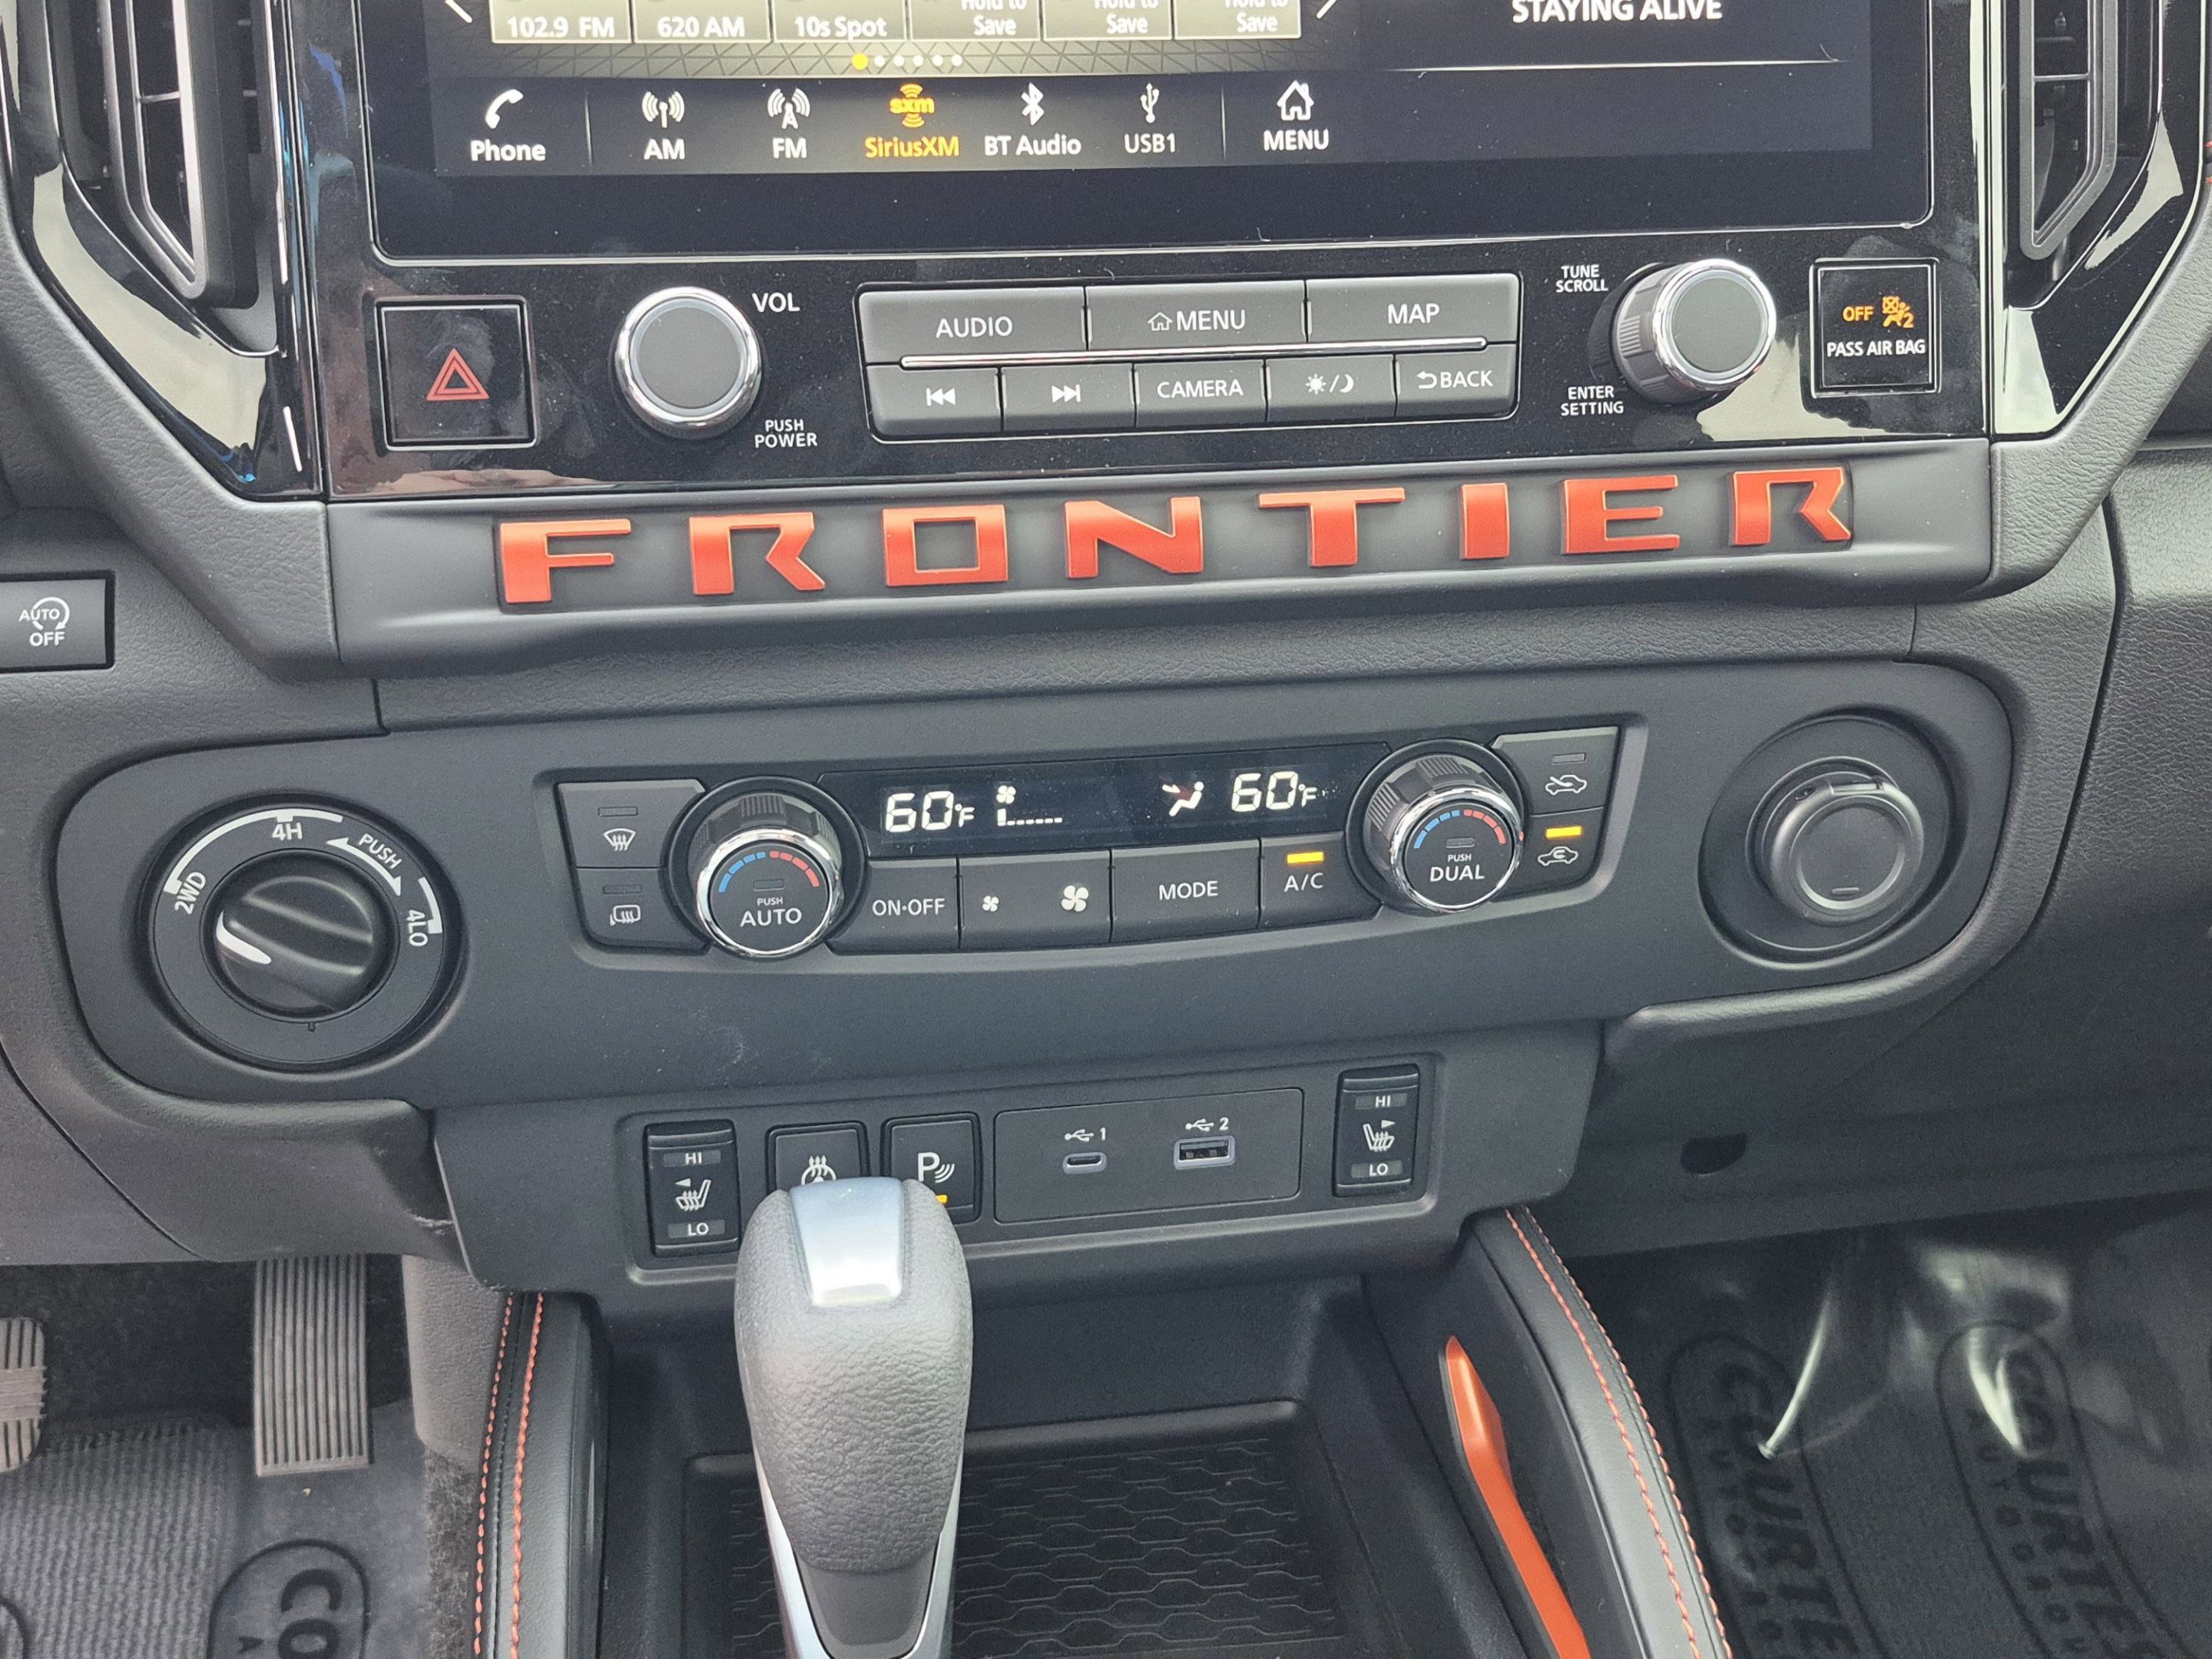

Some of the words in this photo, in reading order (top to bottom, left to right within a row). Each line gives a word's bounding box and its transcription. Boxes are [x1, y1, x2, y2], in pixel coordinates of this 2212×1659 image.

[1512, 0, 1634, 23] STAYING
[1640, 0, 1724, 21] ALIVE
[505, 15, 570, 38] 102.9
[579, 15, 615, 38] FM
[657, 15, 699, 38] 620
[702, 14, 747, 40] AM
[794, 15, 830, 38] 10s
[835, 15, 888, 41] Spot
[972, 15, 1018, 36] Save
[1105, 12, 1149, 35] Save
[1235, 12, 1279, 33] Save
[889, 97, 935, 114] sxm
[470, 138, 546, 161] Phone
[644, 138, 685, 160] AM
[772, 137, 807, 159] FM
[863, 134, 961, 160] SiriusXM
[984, 134, 1012, 156] BT
[1015, 133, 1082, 156] Audio
[1124, 133, 1175, 154] USB1
[1263, 128, 1330, 151] MENU
[1560, 264, 1600, 279] TUNE
[1555, 278, 1608, 293] SCROLL
[752, 292, 800, 313] VOL
[1177, 310, 1246, 331] MENU
[1388, 303, 1440, 324] MAP
[1843, 306, 1874, 322] OFF
[935, 316, 1013, 338] AUDIO
[1826, 341, 1864, 357] PASS
[1866, 339, 1892, 356] AIR
[1896, 339, 1926, 355] BAG
[1157, 379, 1244, 399] CAMERA
[1440, 369, 1493, 389] BACK
[1568, 385, 1614, 400] ENTER
[1560, 400, 1624, 416] SETTING
[765, 419, 805, 433] PUSH
[754, 432, 818, 449] POWER
[498, 465, 1855, 605] FRONTIER
[18, 608, 61, 622] AUTO
[29, 631, 65, 647] OFF
[271, 822, 303, 841] 4H
[359, 833, 402, 869] PUSH
[1447, 853, 1472, 863] PUSH
[1283, 872, 1323, 892] A/C
[1429, 864, 1485, 882] DUAL
[174, 871, 207, 915] 2WD
[1159, 880, 1218, 900] MODE
[757, 896, 783, 906] PUSH
[740, 907, 803, 927] AUTO
[406, 909, 429, 947] 4LO
[1373, 1092, 1393, 1109] HI
[1218, 1115, 1230, 1132] 2
[1098, 1126, 1108, 1143] 1
[684, 1151, 704, 1167] HI
[1367, 1161, 1389, 1179] LO
[687, 1221, 710, 1237] LO
